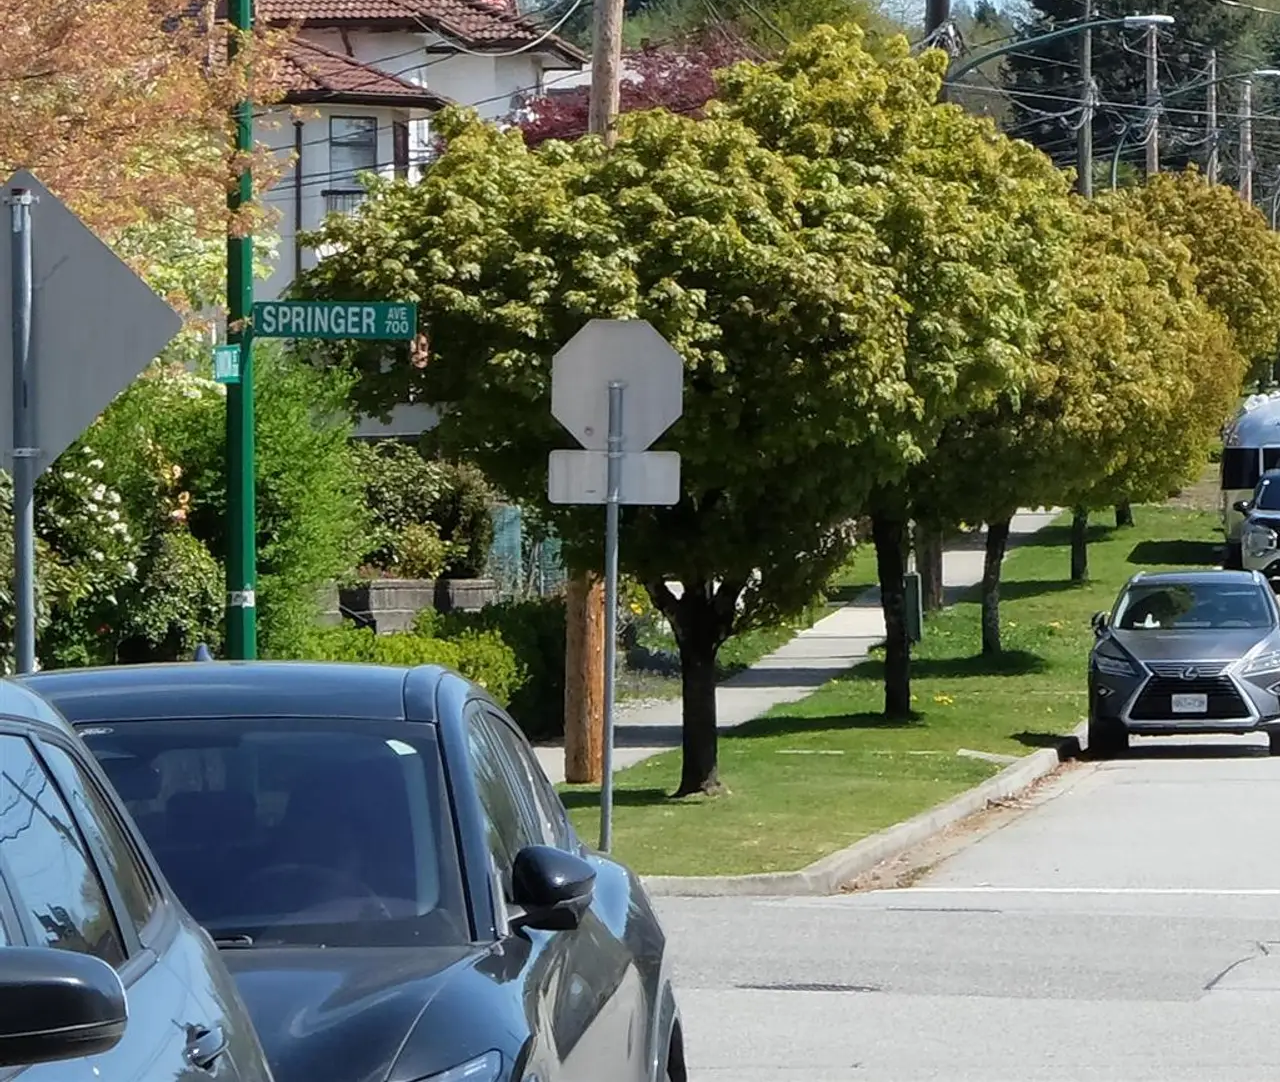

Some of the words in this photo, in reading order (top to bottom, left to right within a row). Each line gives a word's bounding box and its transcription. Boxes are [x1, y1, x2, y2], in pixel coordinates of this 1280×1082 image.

[262, 305, 376, 334] SPRINGER
[387, 307, 408, 320] AVE
[384, 321, 409, 334] 700
